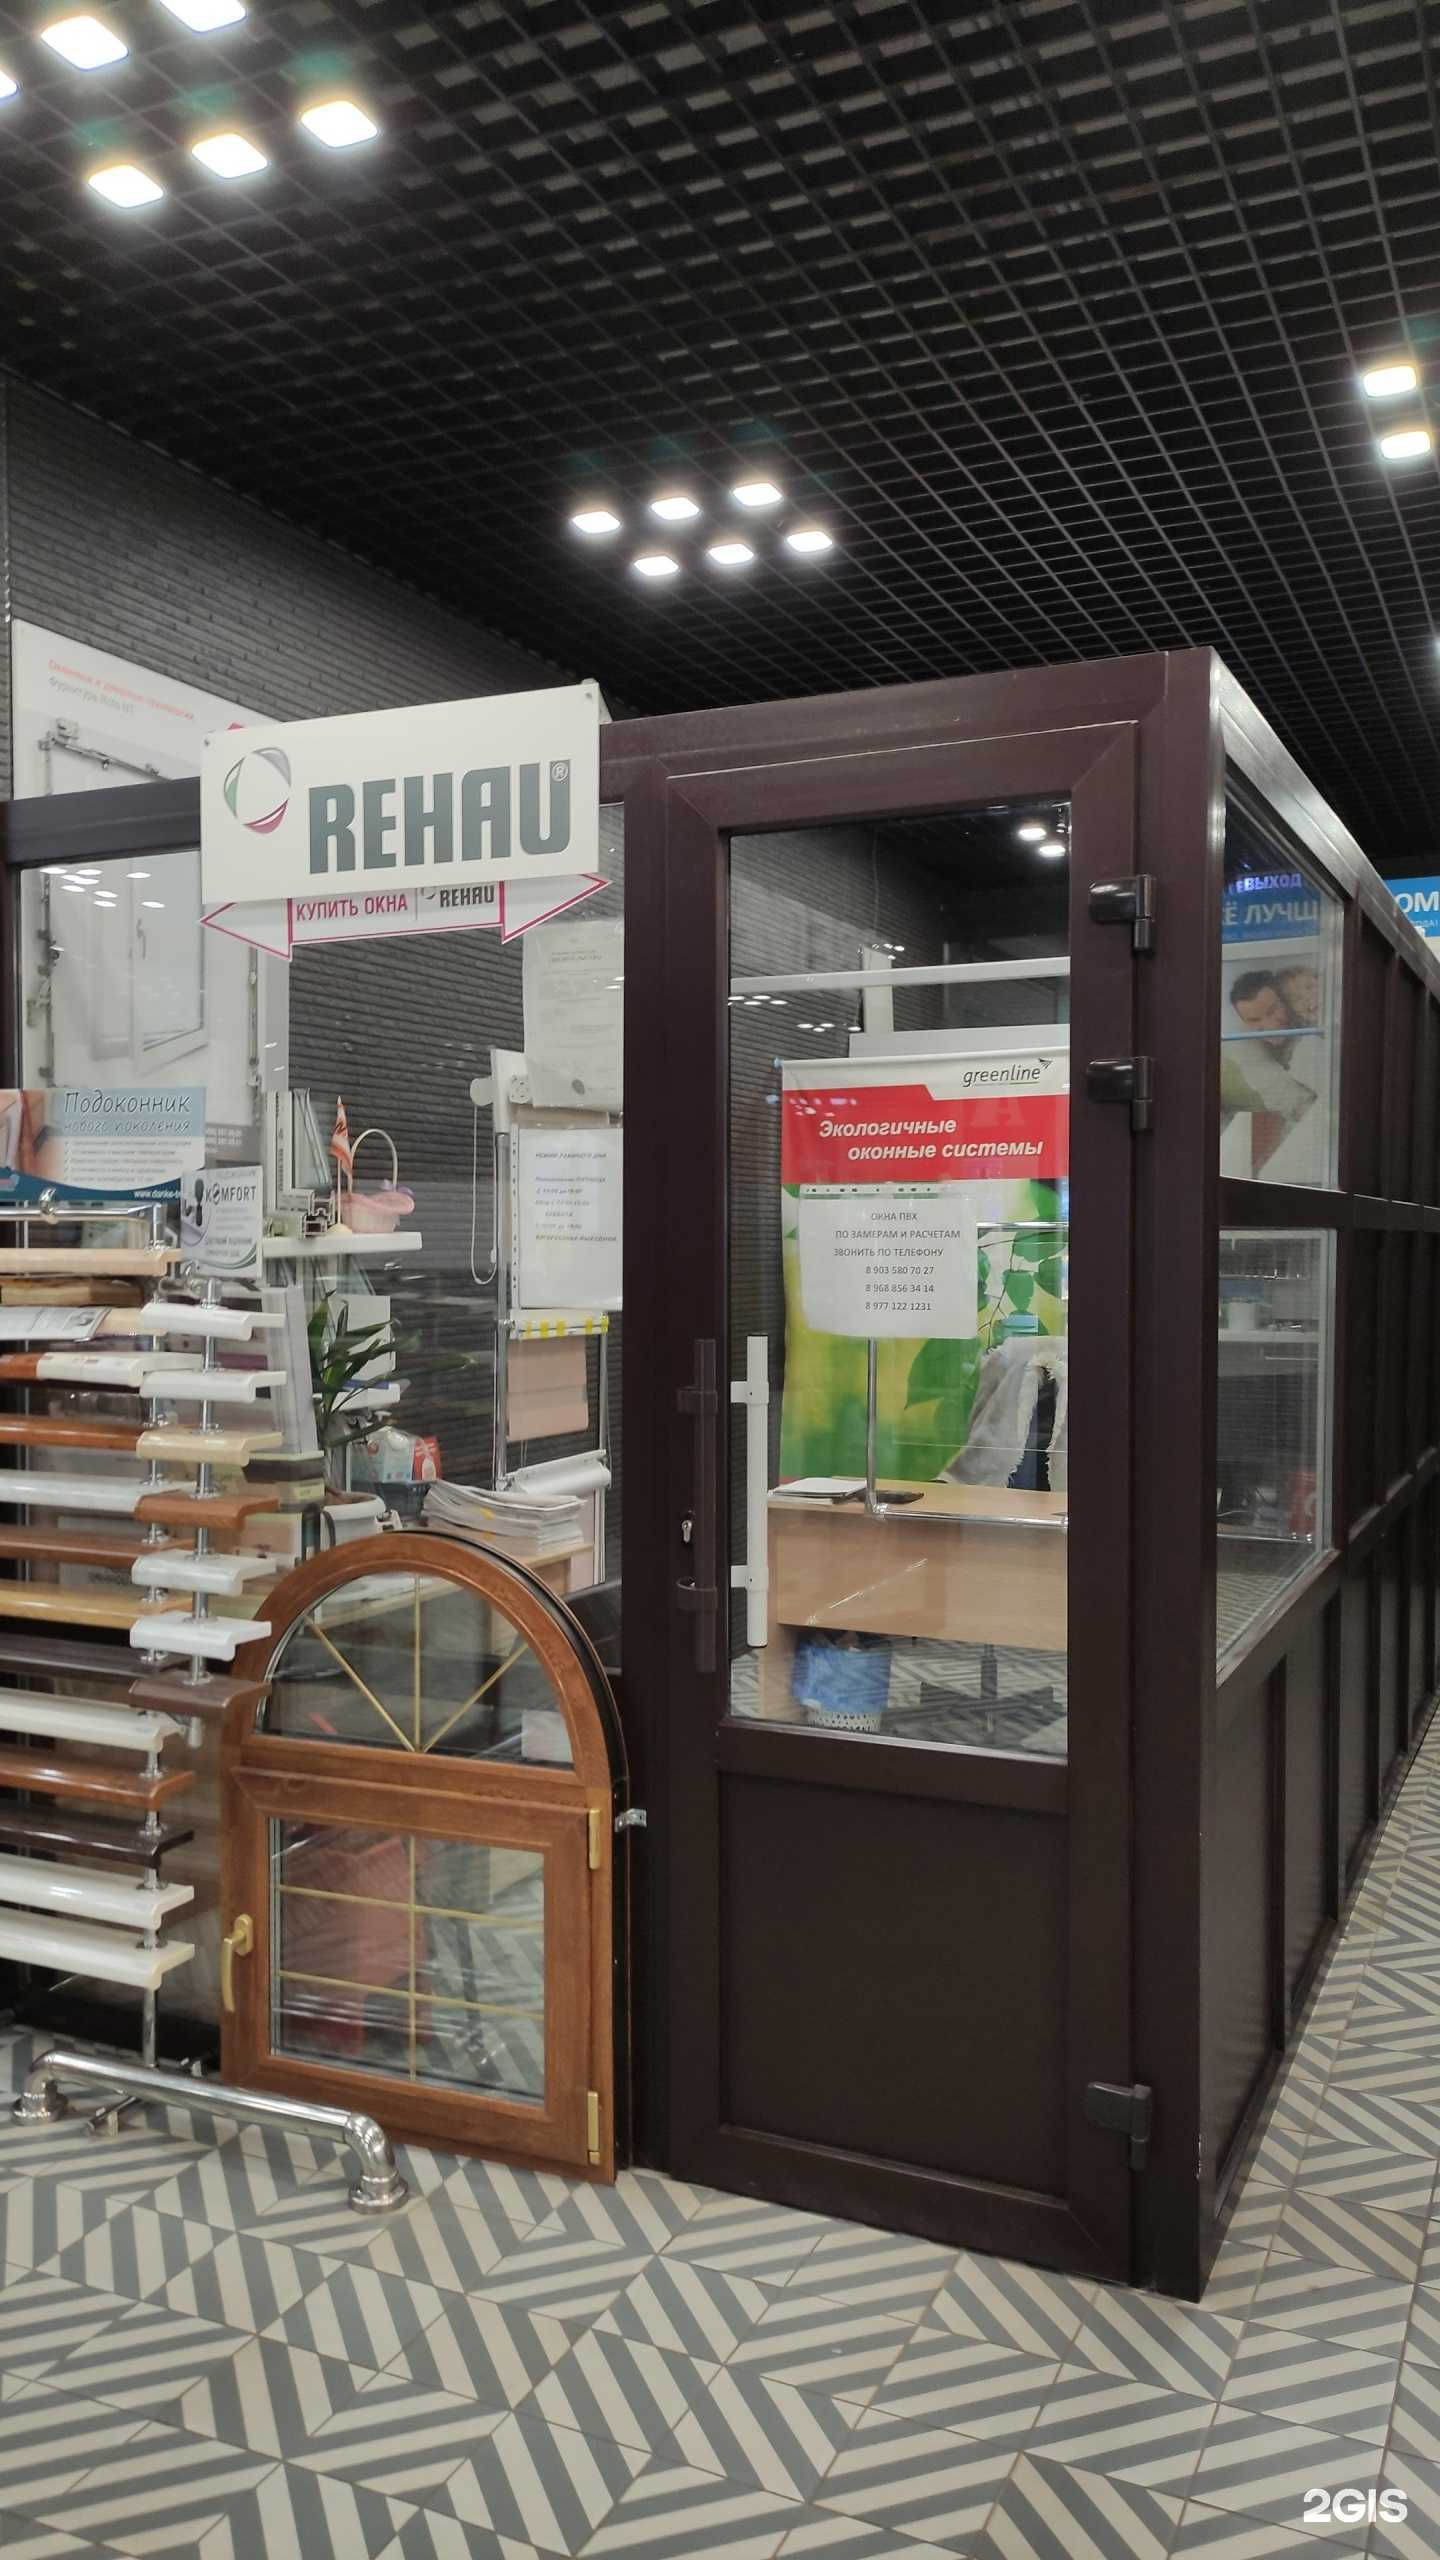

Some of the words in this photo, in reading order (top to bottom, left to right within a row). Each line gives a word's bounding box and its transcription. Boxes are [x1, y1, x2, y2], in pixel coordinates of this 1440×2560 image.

[439, 884, 495, 908] REHAU
[296, 898, 359, 922] КУПИТЬ
[364, 893, 408, 916] ОКНА
[1222, 901, 1238, 926] Ё
[962, 1064, 1041, 1087] greenline
[64, 1089, 191, 1114] Подоконник
[819, 1118, 957, 1138] Экологичные
[847, 1143, 937, 1160] оконные
[941, 1140, 1044, 1158] системы
[871, 1212, 896, 1221] ОКНА
[899, 1212, 918, 1221] ПВХ
[835, 1230, 849, 1239] ПО
[852, 1230, 898, 1239] ЗАМЕРАМ
[910, 1230, 961, 1239] РАСЧЕТАМ
[834, 1248, 875, 1257] ЗВОНИТЬ
[877, 1248, 892, 1257] ПО
[894, 1247, 944, 1257] ТЕЛЕФОНУ
[865, 1265, 871, 1275] 8
[873, 1265, 889, 1275] 903
[892, 1265, 908, 1275] 580
[910, 1265, 921, 1275] 70
[923, 1265, 934, 1275] 27
[865, 1283, 871, 1293] 8
[873, 1283, 889, 1293] 968
[891, 1283, 908, 1293] 856
[910, 1283, 921, 1293] 34
[923, 1283, 934, 1293] 14
[865, 1301, 871, 1311] 8
[873, 1301, 889, 1311] 977
[892, 1301, 907, 1311] 122
[910, 1301, 932, 1311] 1231
